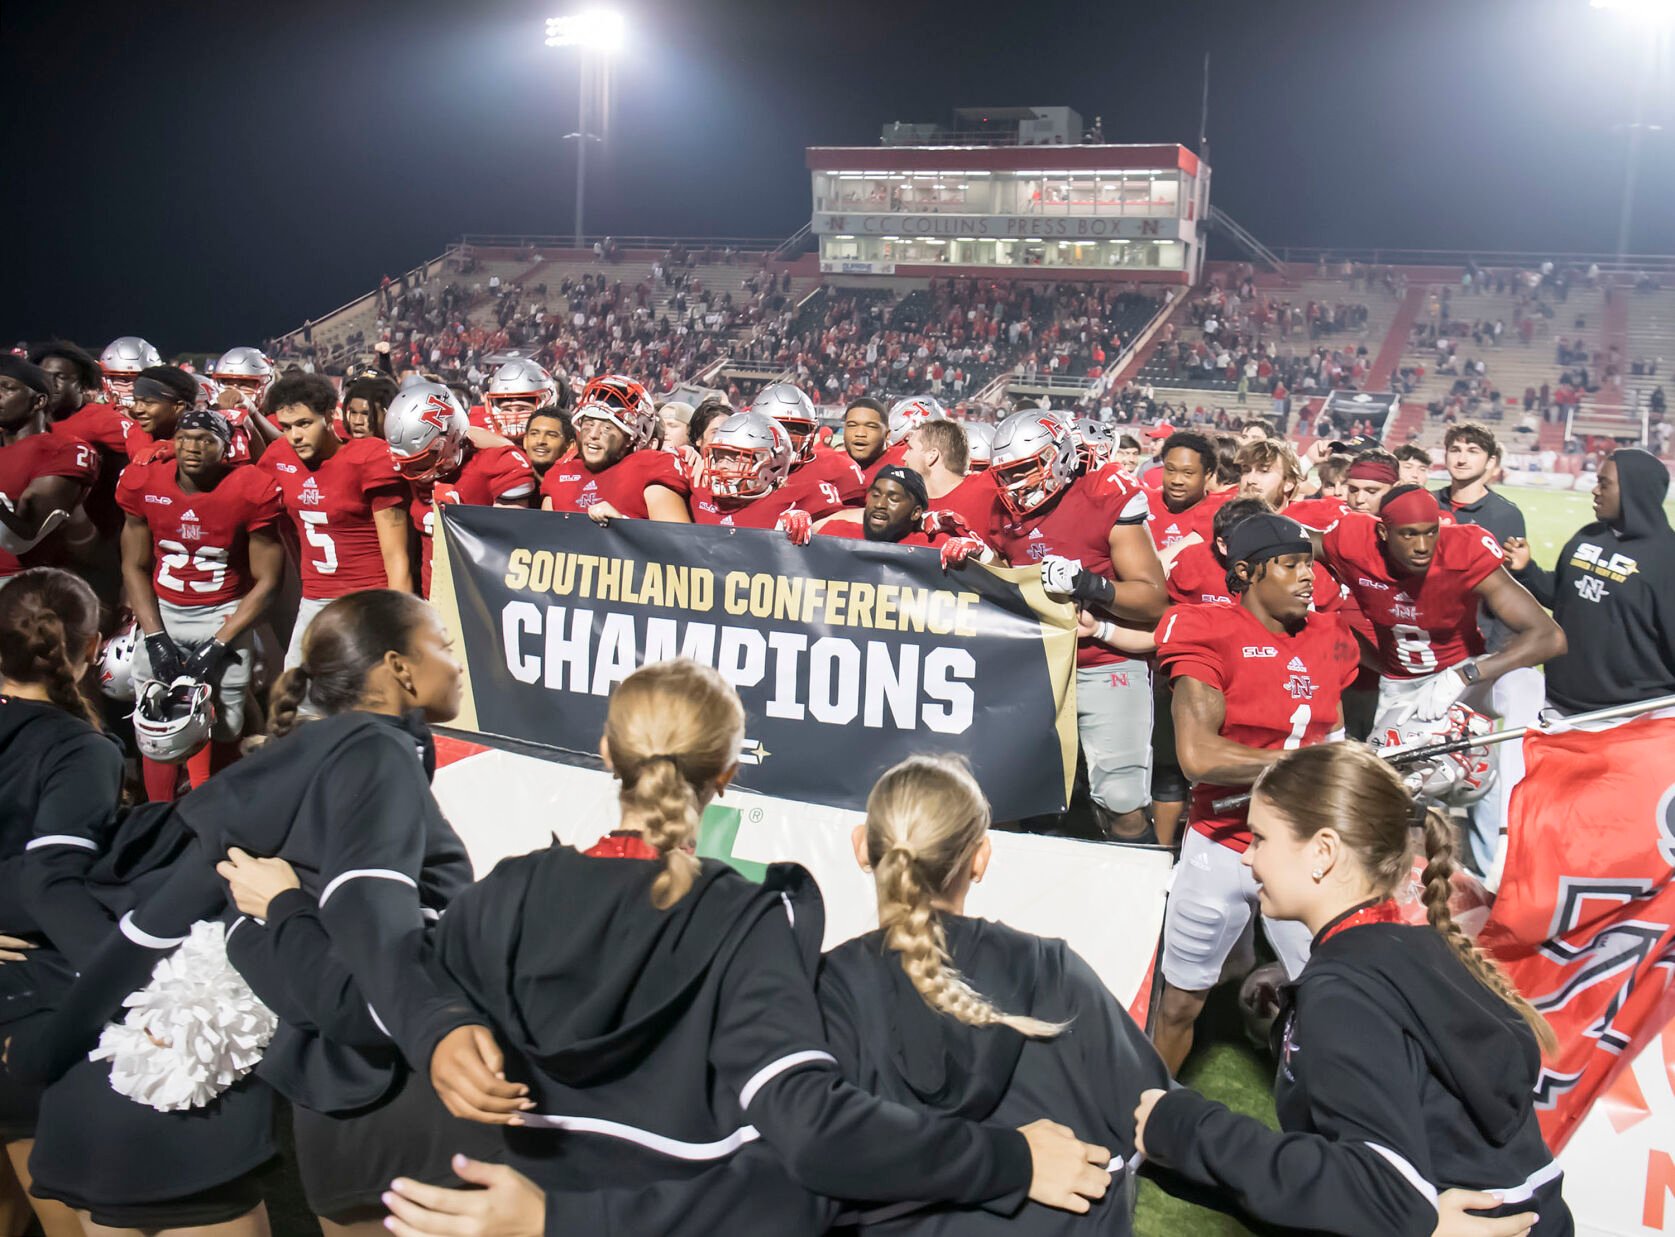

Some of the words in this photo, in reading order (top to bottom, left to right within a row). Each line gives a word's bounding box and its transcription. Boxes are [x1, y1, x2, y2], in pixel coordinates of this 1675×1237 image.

[902, 216, 988, 234] COLLINS
[1007, 218, 1067, 235] PRESS
[1078, 219, 1121, 235] BOX
[298, 509, 338, 574] 5
[1481, 535, 1504, 559] 8
[504, 547, 714, 612] SOUTHLAND
[723, 570, 980, 637] CONFERENCE
[1242, 646, 1278, 658] SLC
[1391, 623, 1439, 674] 8
[1283, 703, 1312, 751] 1
